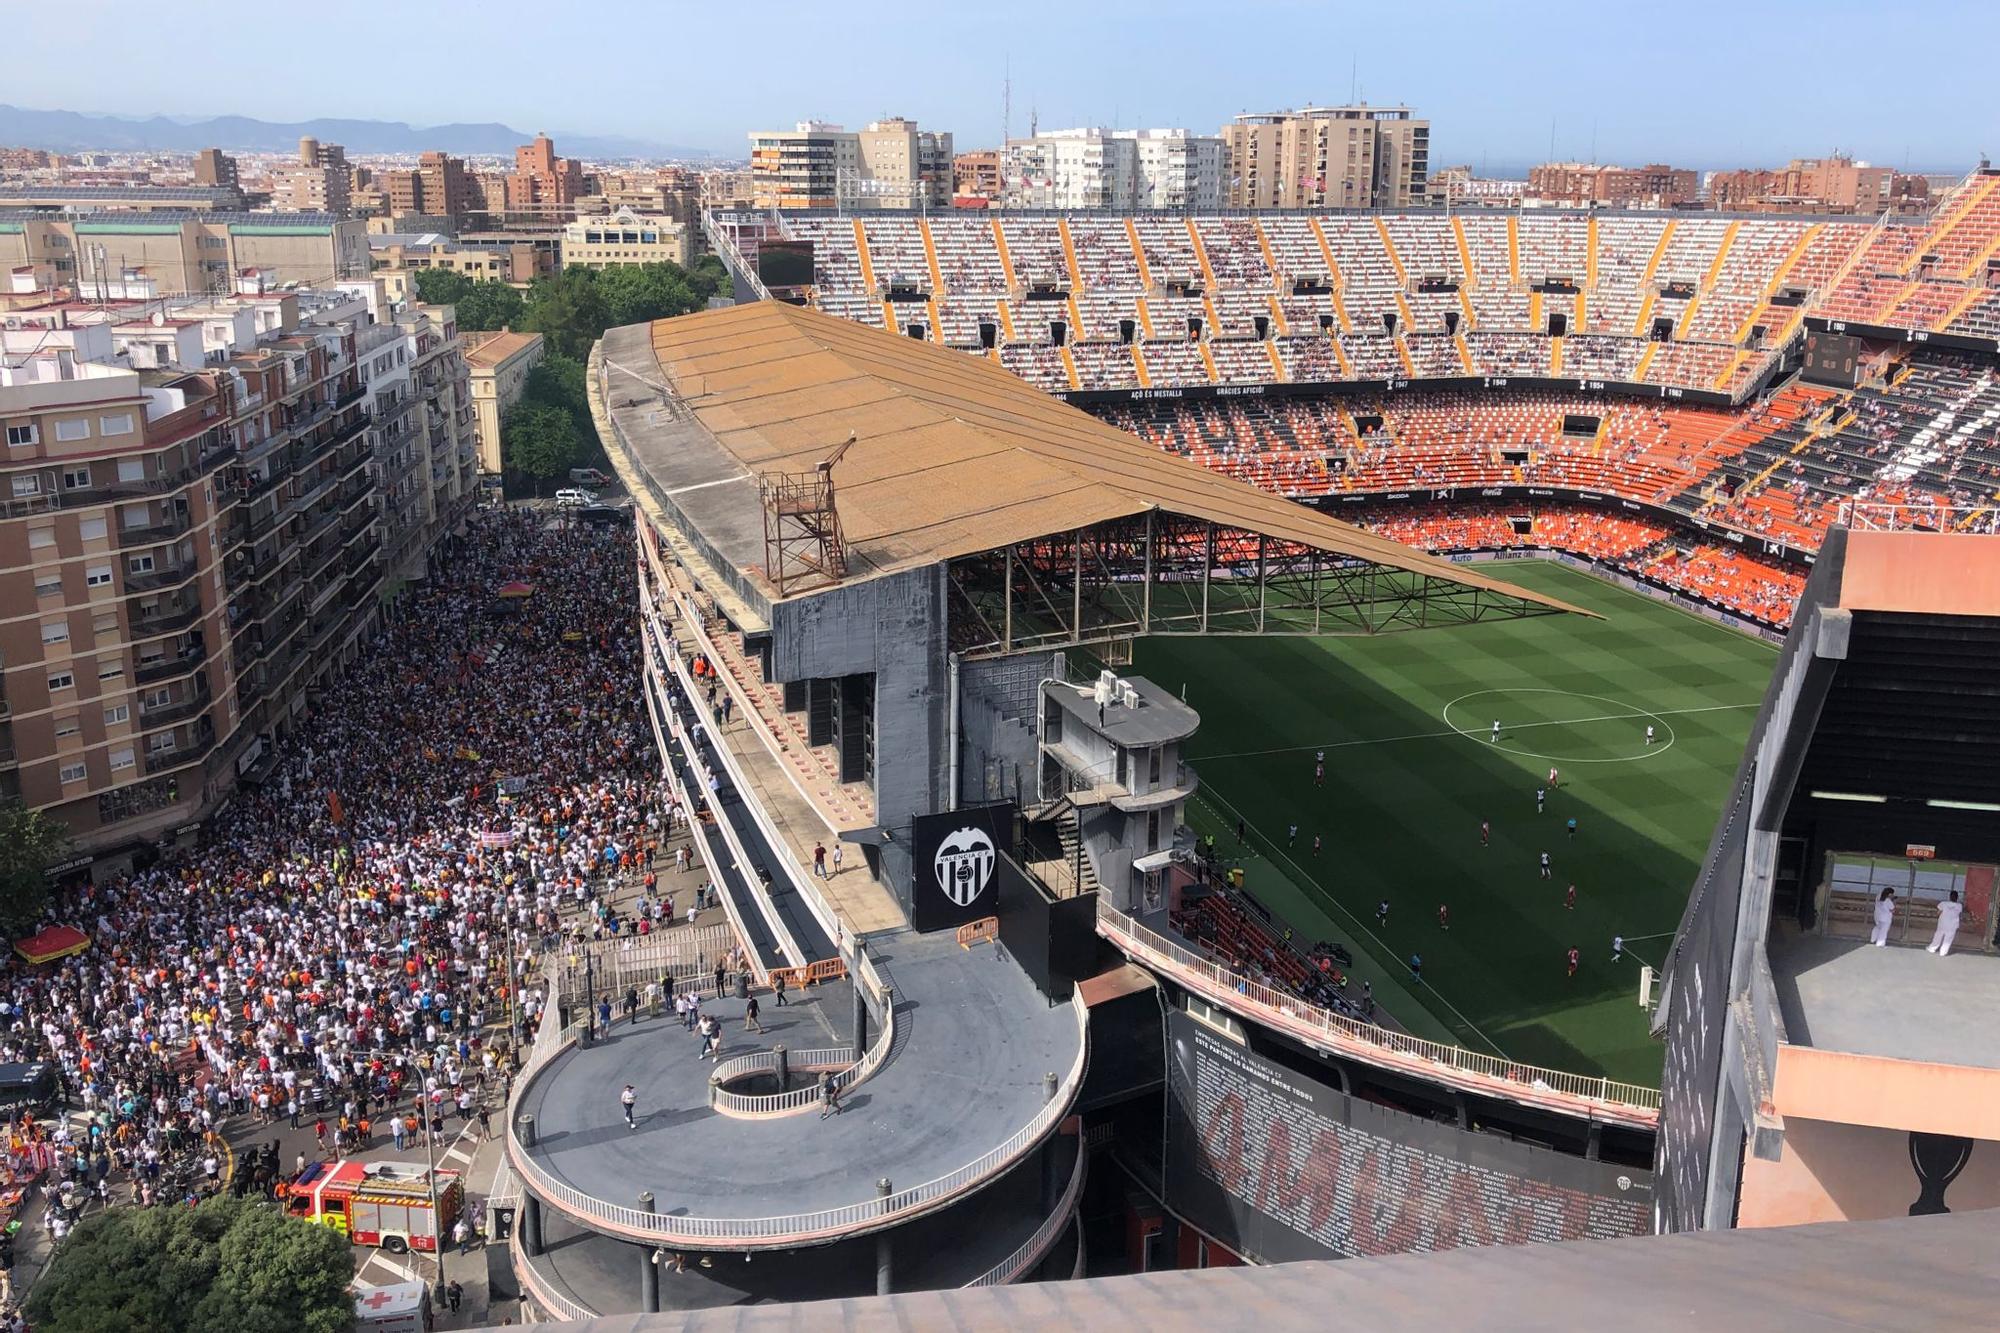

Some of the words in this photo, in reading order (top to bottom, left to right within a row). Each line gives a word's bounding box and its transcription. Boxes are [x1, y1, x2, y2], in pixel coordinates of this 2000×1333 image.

[1834, 322, 1846, 331] 1963
[1916, 332, 1928, 341] 1967
[1154, 390, 1182, 398] MESTALLA
[1451, 554, 1472, 562] Auto
[1493, 551, 1522, 560] Allianz
[1635, 582, 1652, 594] Auto
[1669, 594, 1692, 610] Allianz
[1720, 613, 1739, 628] Auto
[940, 854, 976, 862] VALENCIA
[1195, 1030, 1220, 1047] EMPRESAS
[1221, 1045, 1239, 1057] UNIDAS
[1248, 1059, 1273, 1075] VALENCIA
[1195, 1037, 1208, 1048] ESTE
[1209, 1045, 1232, 1061] PARTIDO
[1242, 1063, 1270, 1081] GANAMOS
[1271, 1078, 1291, 1091] ENTRE
[1292, 1087, 1313, 1102] TODOS
